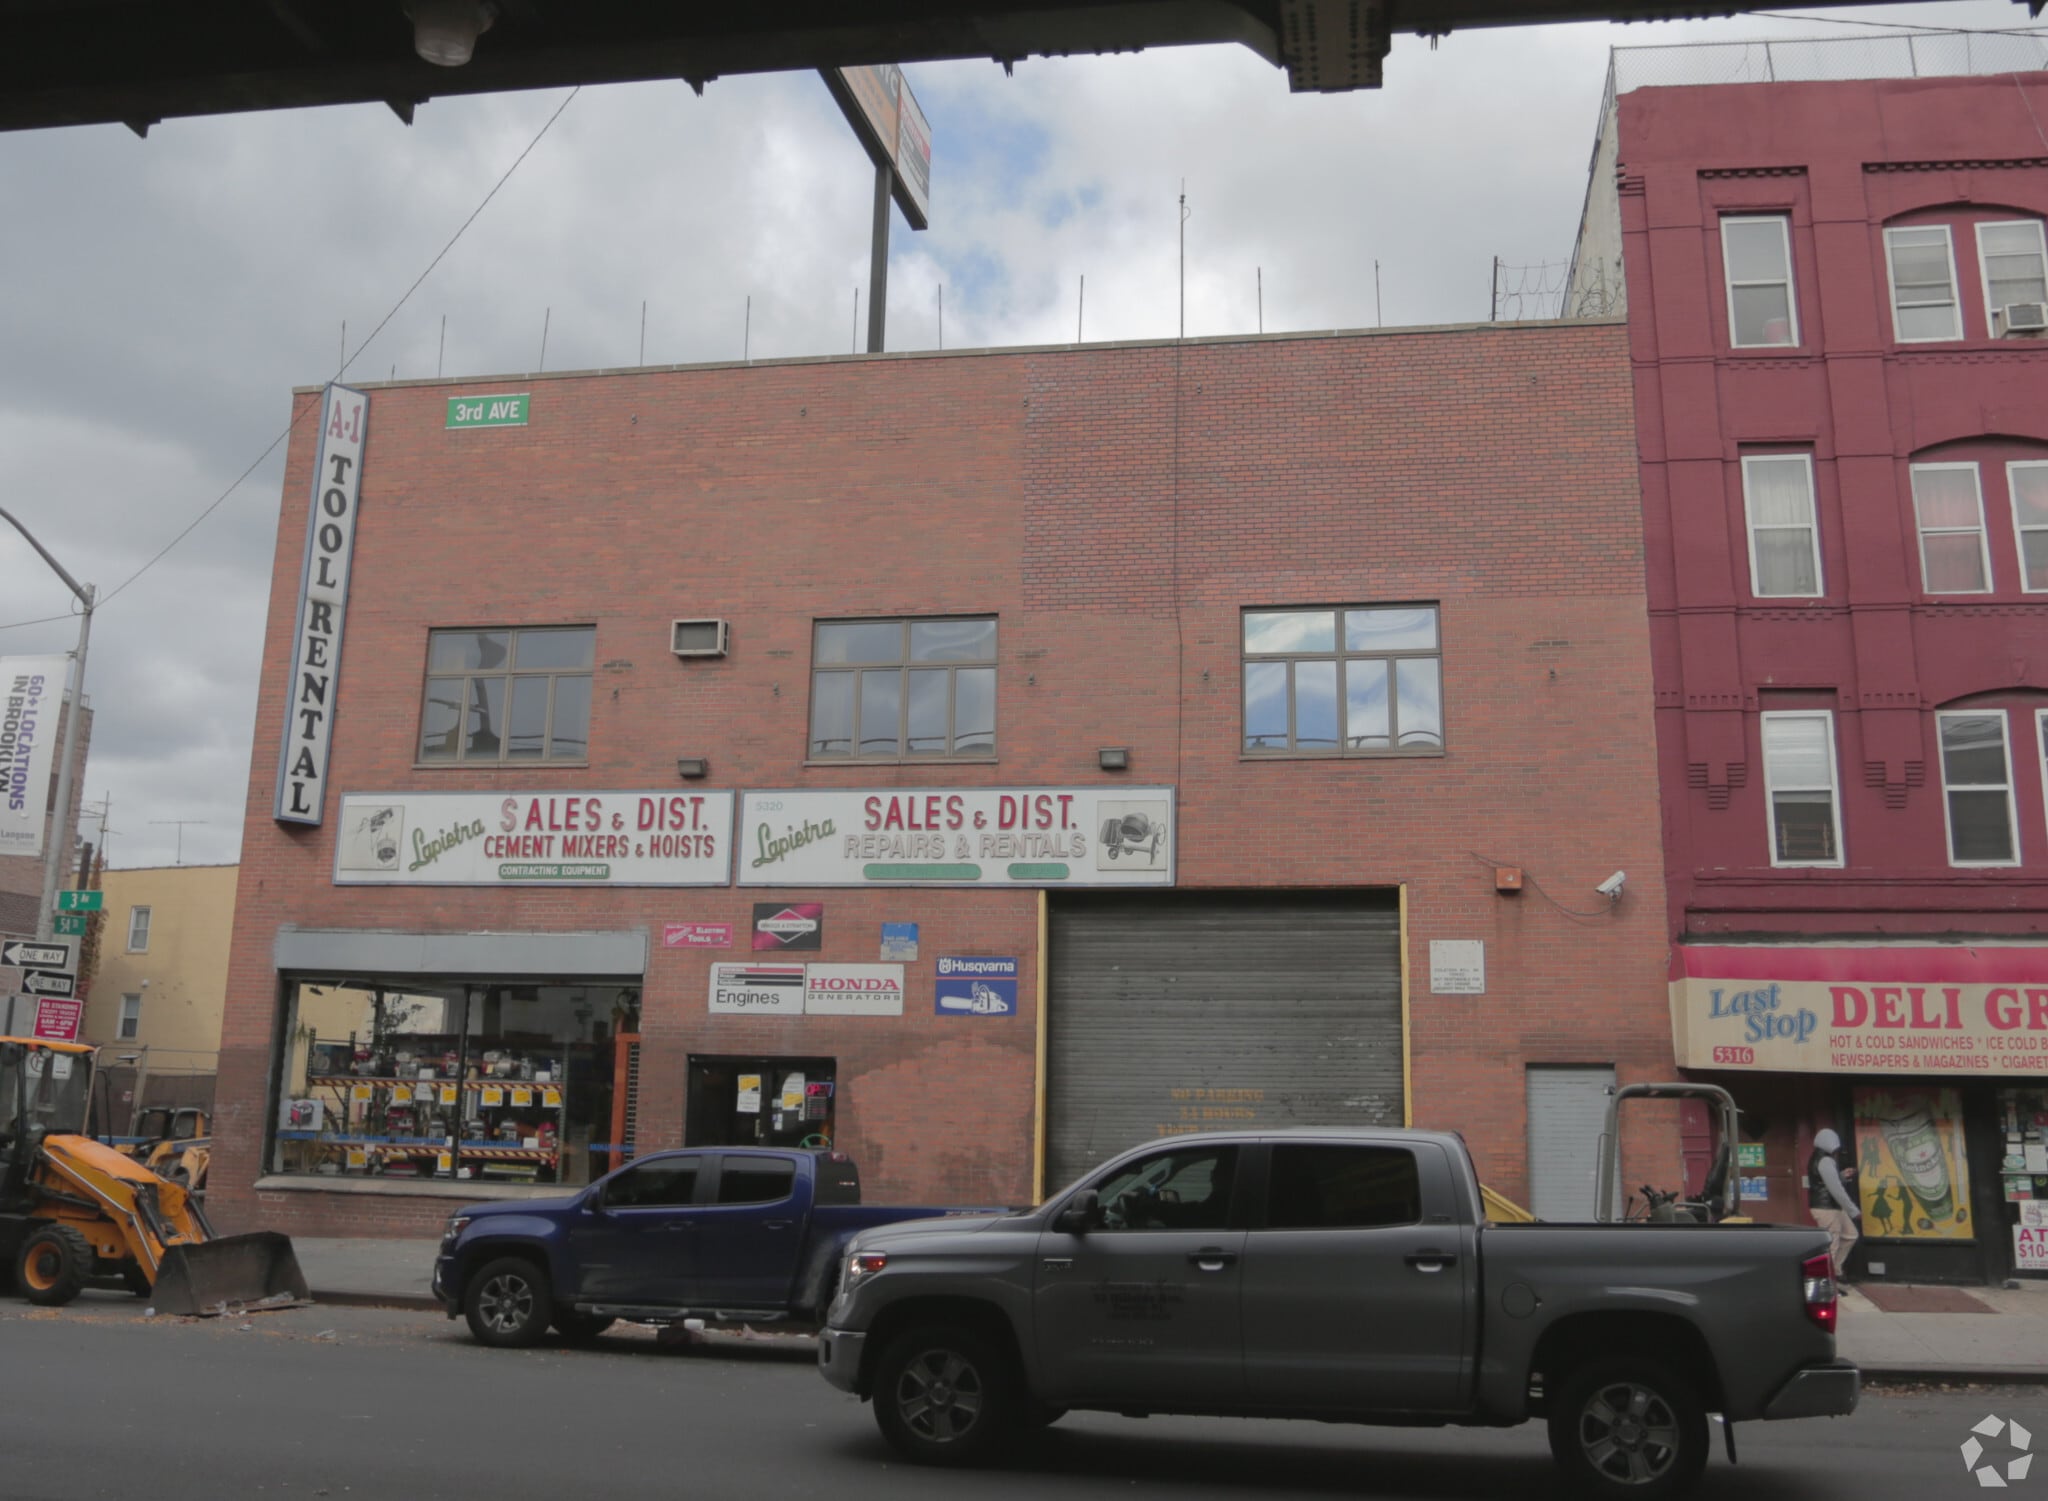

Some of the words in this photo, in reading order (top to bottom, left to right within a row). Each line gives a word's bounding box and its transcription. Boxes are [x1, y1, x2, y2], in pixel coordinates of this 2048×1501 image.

[328, 400, 361, 443] A-1
[455, 402, 483, 421] 3rd
[488, 401, 520, 419] AVE
[316, 454, 352, 588] TOOL
[12, 675, 29, 693] IN
[27, 675, 45, 707] 60+
[290, 600, 332, 814] RENTAL
[8, 709, 38, 810] LOCATIONS
[500, 797, 602, 832] SALES
[611, 811, 625, 829] &
[637, 797, 709, 832] DIST.
[863, 795, 964, 831] SALES
[973, 810, 987, 830] &
[999, 795, 1077, 830] DIST.
[484, 835, 554, 859] CEMENT
[562, 835, 628, 859] MIXERS
[635, 845, 644, 857] &
[650, 835, 715, 858] HOISTS
[844, 834, 945, 858] REPAIRS
[955, 834, 970, 858] &
[979, 833, 1087, 858] RENTALS
[500, 865, 559, 877] CONTRACTING
[561, 865, 607, 877] EQUIPMENT
[70, 893, 78, 908] 3
[20, 949, 38, 961] ONE
[43, 951, 62, 961] WAY
[951, 960, 1015, 973] Husqvarna
[30, 977, 44, 988] ONE
[52, 979, 67, 990] WAY
[808, 978, 900, 991] HONDA
[716, 989, 780, 1007] Engines
[1709, 983, 1781, 1019] Last
[1829, 986, 1963, 1029] DELI
[1745, 1008, 1818, 1045] Stop
[1829, 1035, 1852, 1049] HOT
[1855, 1036, 1863, 1049] &
[1866, 1035, 1895, 1049] COLD
[1899, 1036, 1974, 1050] SANDWICHES
[1986, 1037, 2004, 1050] ICE
[2007, 1037, 2037, 1050] COLD
[1714, 1047, 1752, 1063] 5316
[1831, 1054, 1909, 1068] NEWSPAPERS
[1912, 1055, 1920, 1068] &
[1923, 1055, 1989, 1069] MAGAZINES
